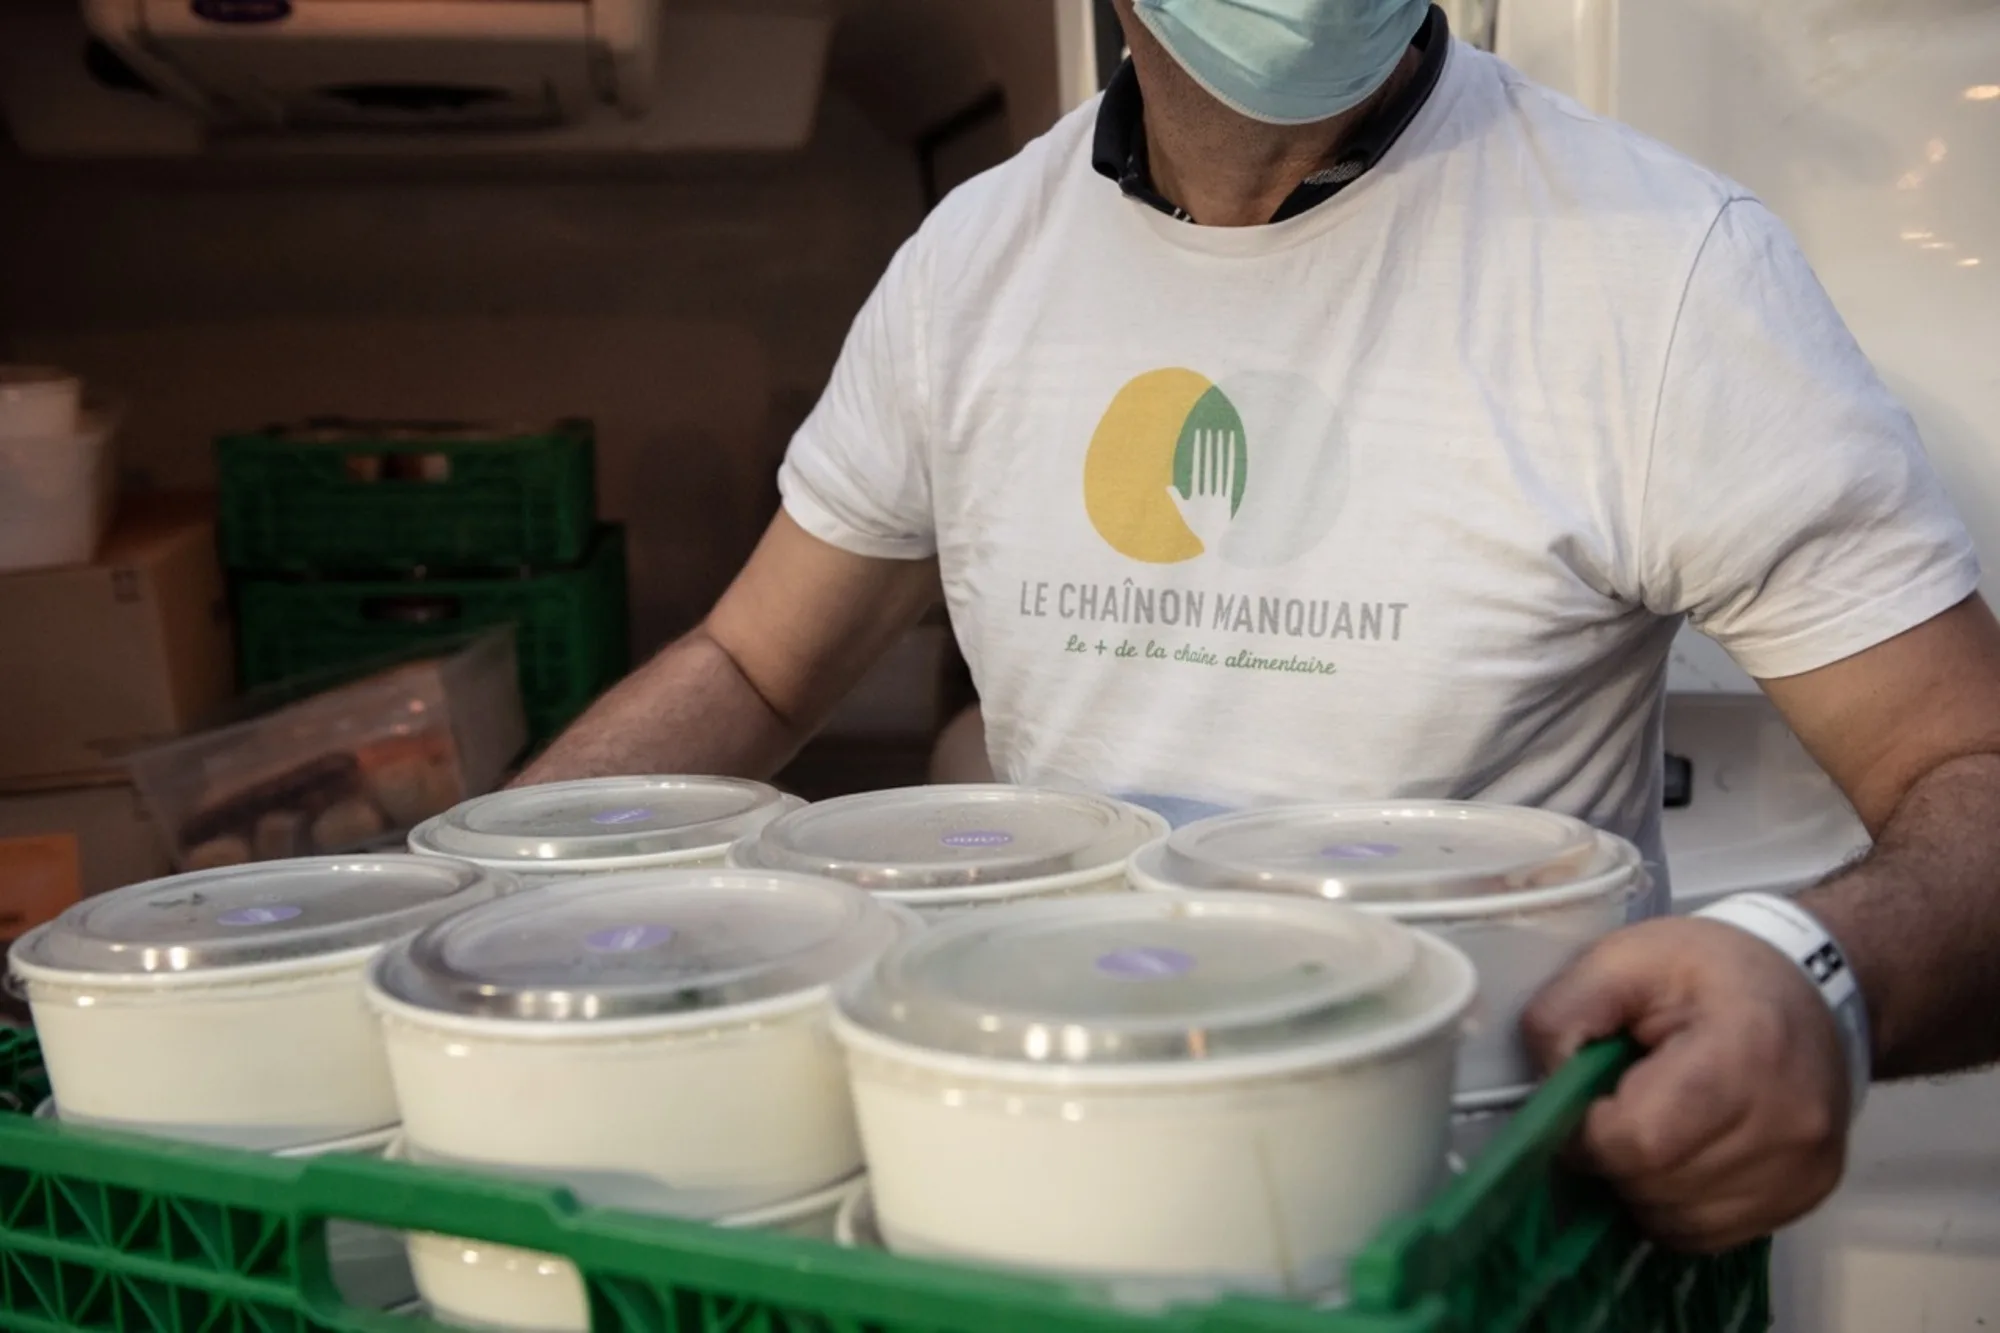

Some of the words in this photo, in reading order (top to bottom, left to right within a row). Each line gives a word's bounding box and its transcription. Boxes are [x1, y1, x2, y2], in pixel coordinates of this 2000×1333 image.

[1020, 580, 1049, 617] LE
[1058, 577, 1205, 629] CHAÎNON
[1212, 592, 1409, 641] MANQUANT
[1094, 639, 1107, 656] +
[1114, 639, 1138, 658] de
[1145, 639, 1168, 659] la
[1224, 648, 1337, 675] alimentaire
